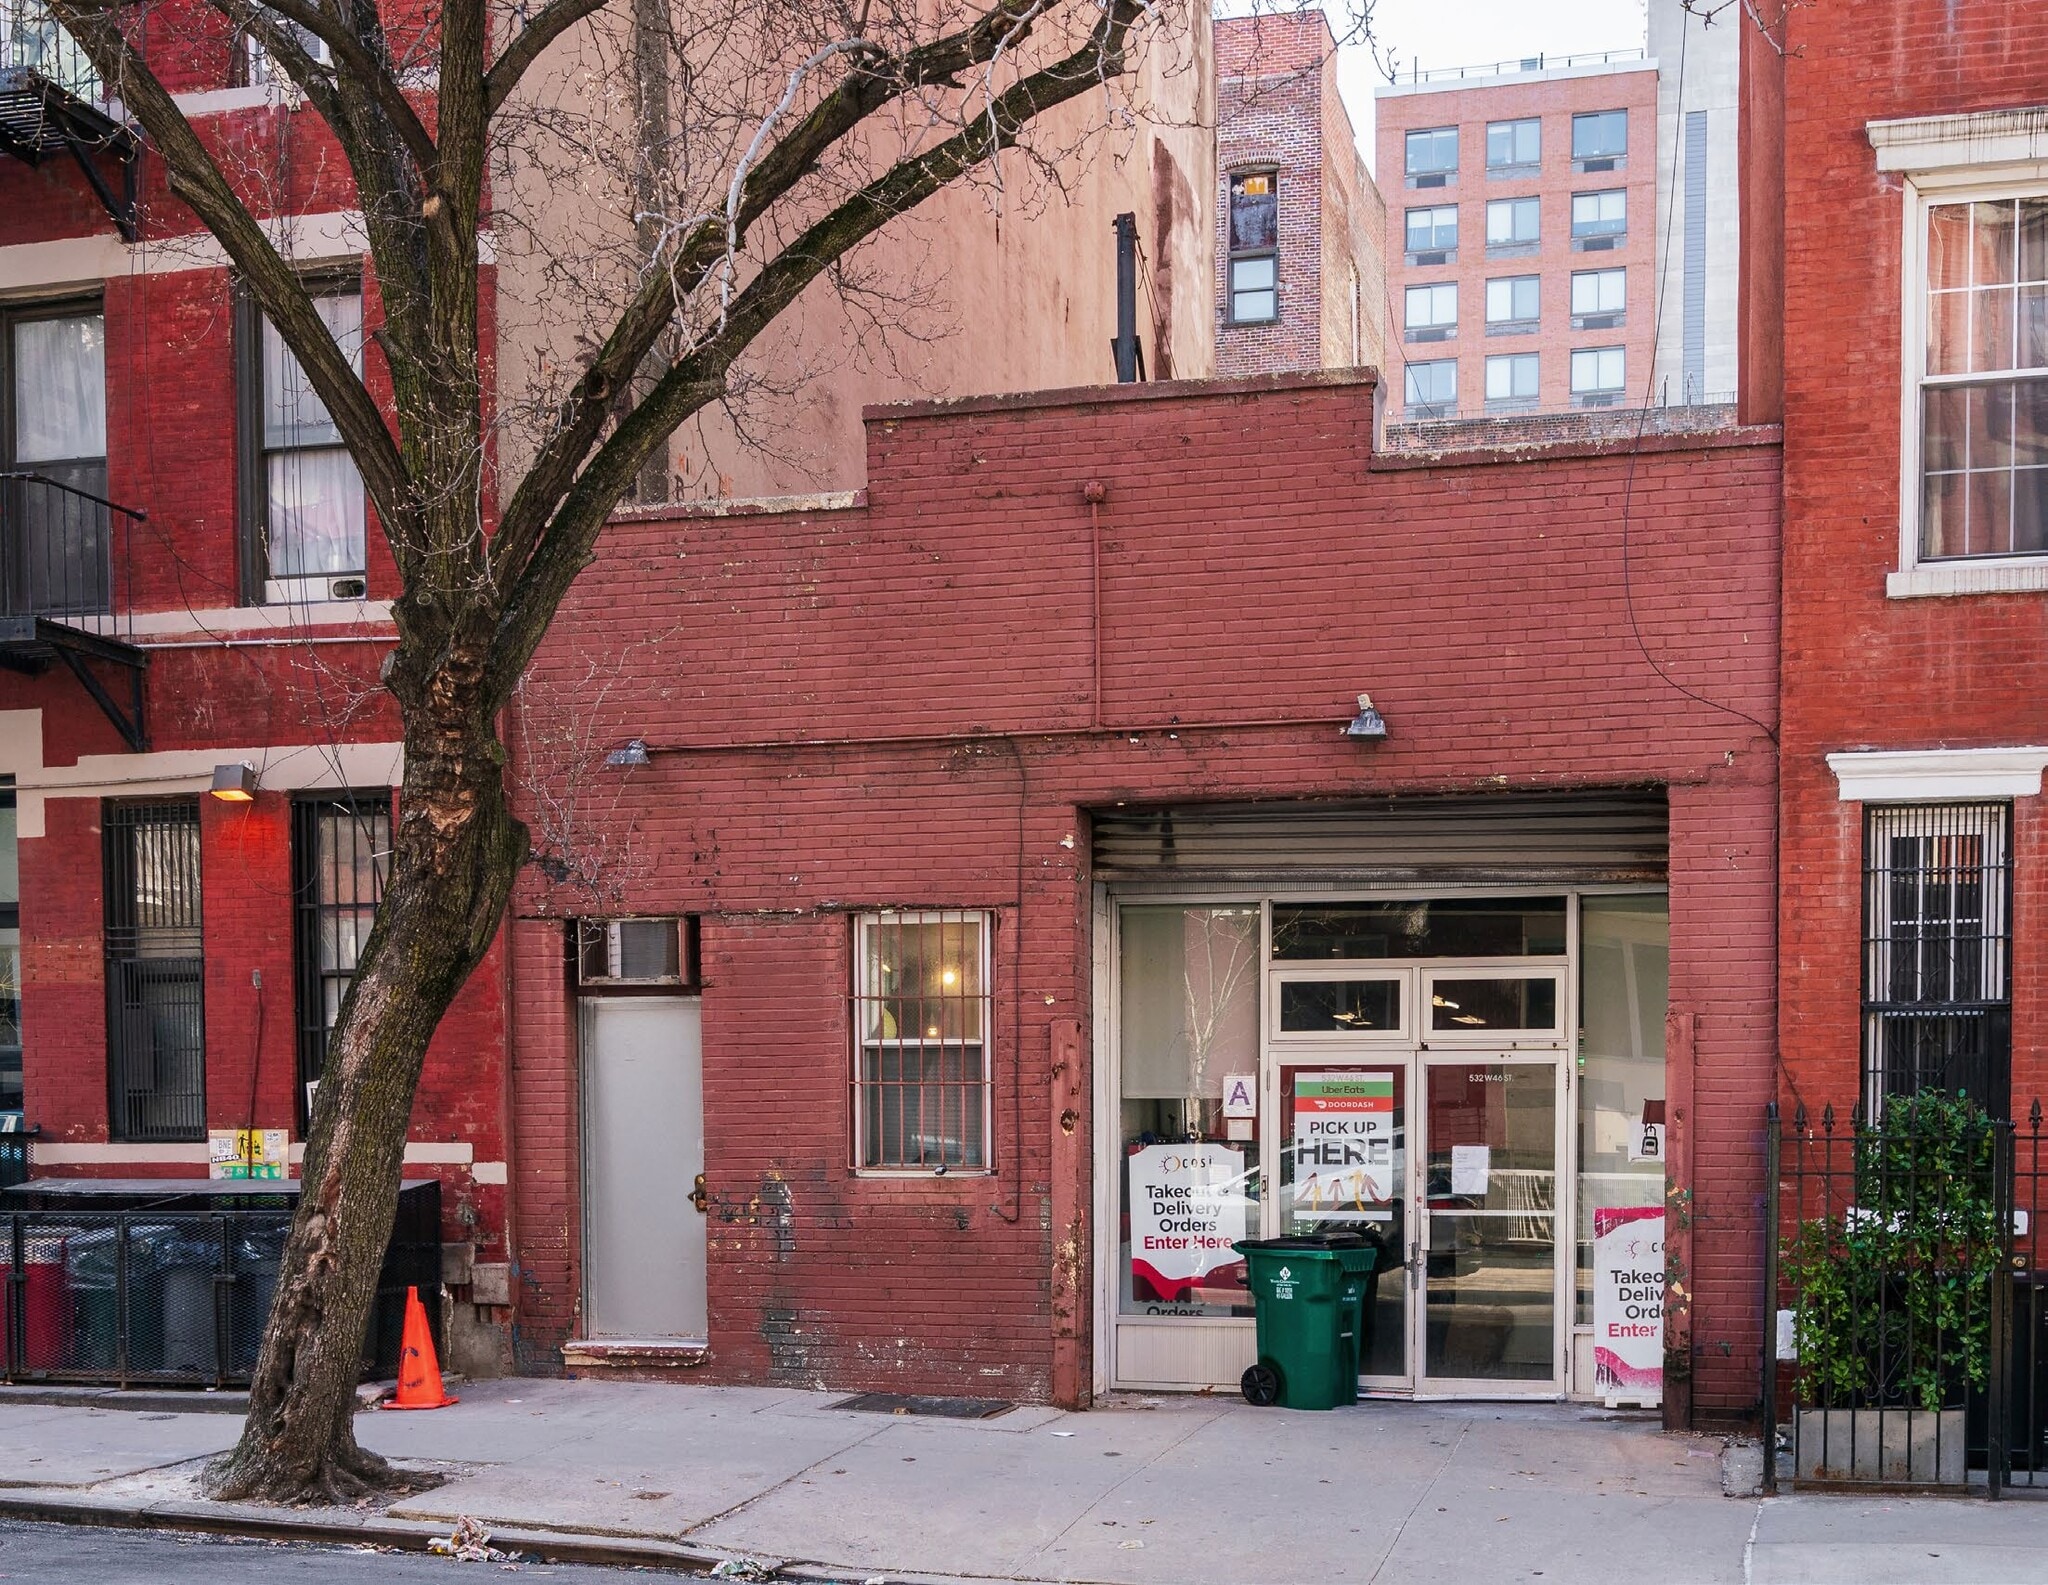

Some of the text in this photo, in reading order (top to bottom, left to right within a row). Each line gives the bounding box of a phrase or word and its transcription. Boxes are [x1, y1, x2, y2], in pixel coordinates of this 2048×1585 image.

[1468, 1074, 1484, 1082] 532
[1228, 1081, 1251, 1106] A
[1321, 1086, 1365, 1094] Uber Eats
[1310, 1121, 1377, 1134] PICK UP
[1297, 1138, 1389, 1165] HERE
[1153, 1200, 1221, 1217] Delivery
[1159, 1217, 1217, 1232] Orders
[1144, 1235, 1233, 1249] Enter Here
[1608, 1323, 1658, 1337] Enter
